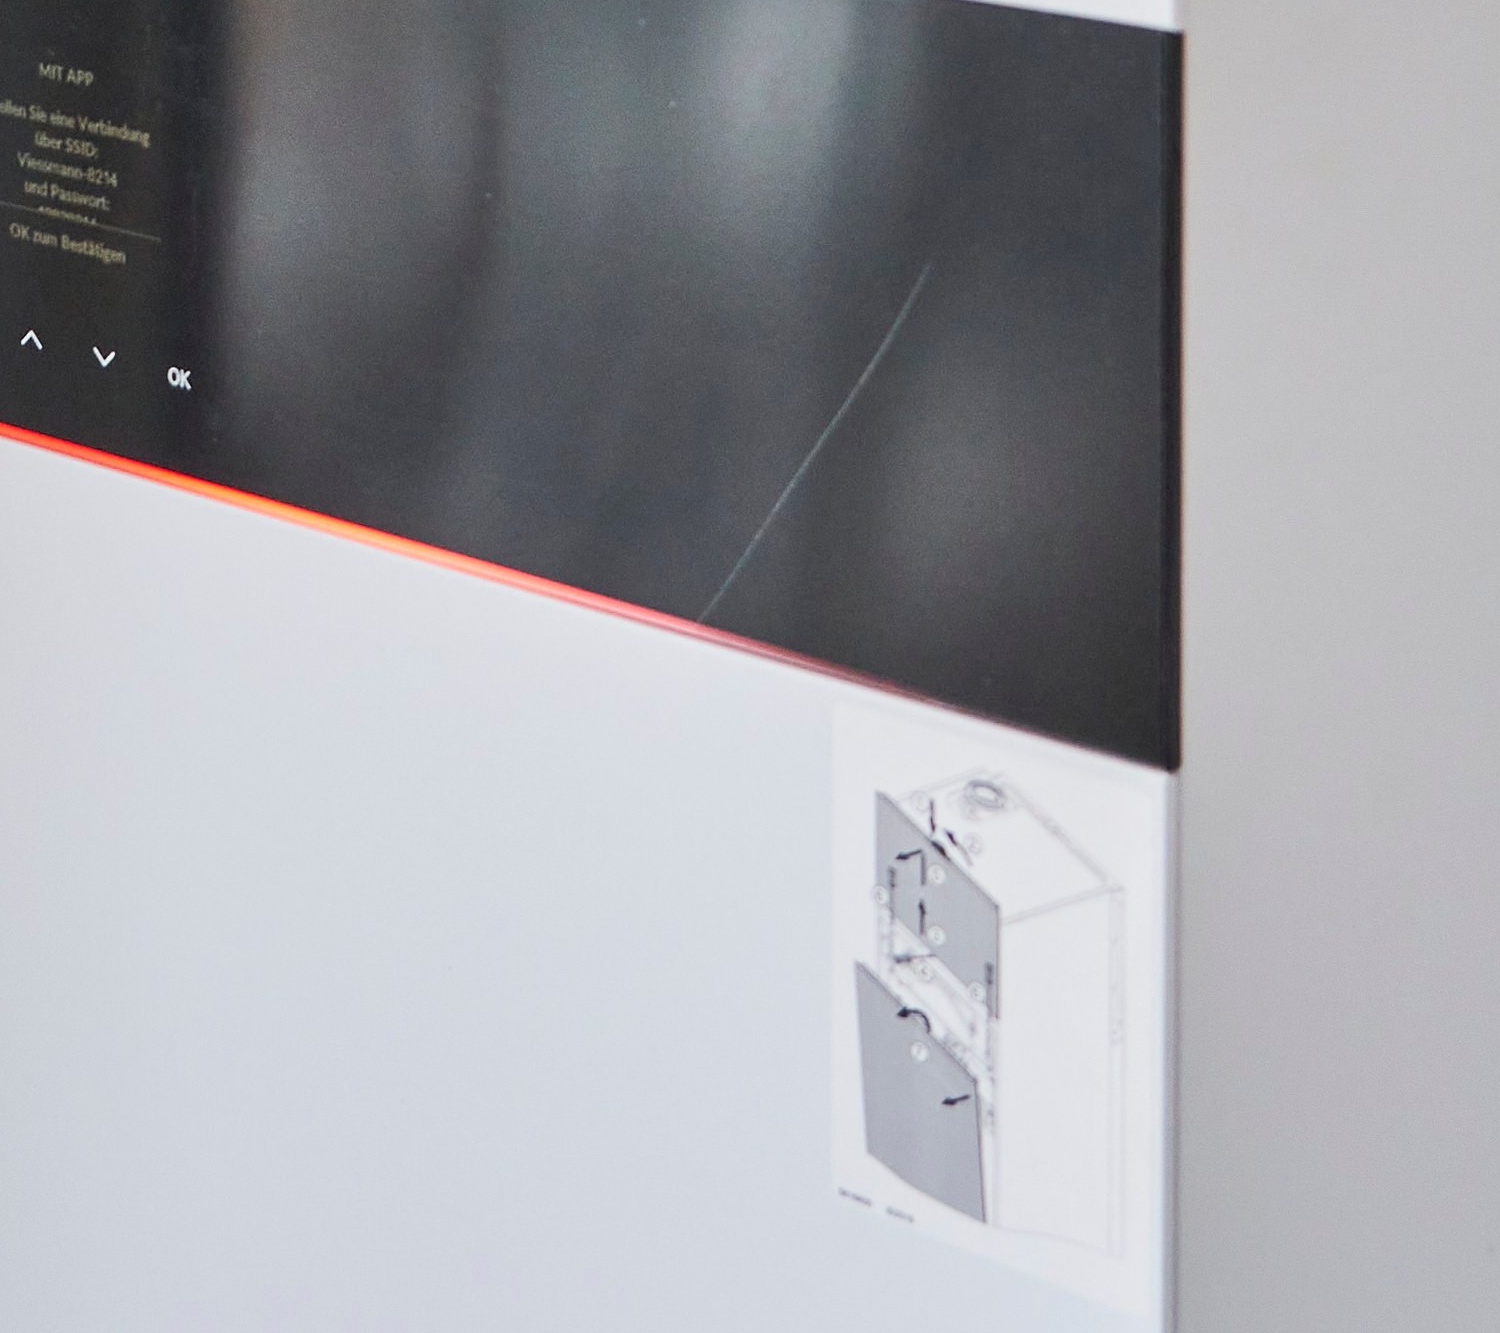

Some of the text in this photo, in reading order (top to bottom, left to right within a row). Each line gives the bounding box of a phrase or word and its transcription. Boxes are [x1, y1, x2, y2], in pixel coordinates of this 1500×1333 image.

[38, 61, 94, 86] MIT APP
[29, 104, 48, 123] Sie
[49, 109, 75, 129] eine
[78, 115, 150, 149] Verbindung
[24, 180, 110, 211] und Passwort:
[9, 222, 127, 265] OK zum Bestätigen
[167, 366, 192, 391] OK
